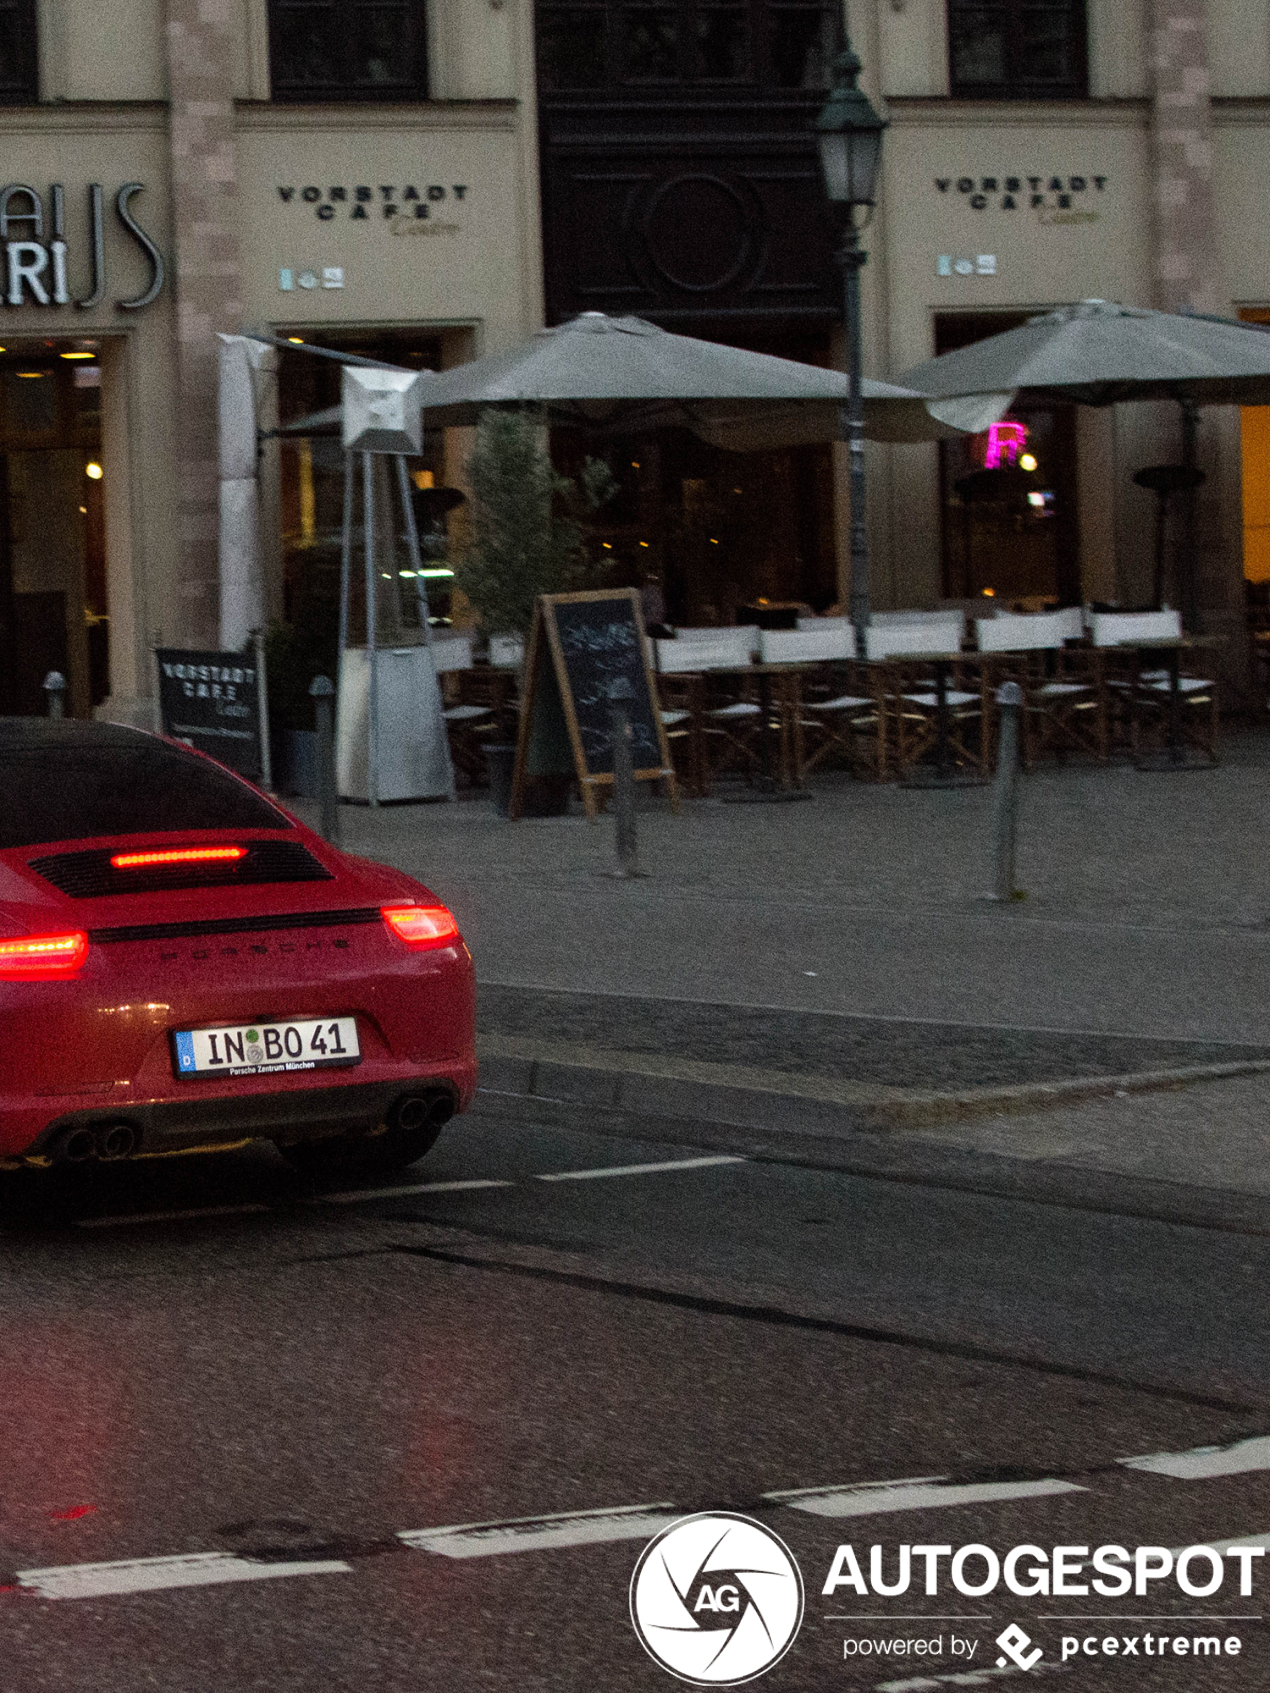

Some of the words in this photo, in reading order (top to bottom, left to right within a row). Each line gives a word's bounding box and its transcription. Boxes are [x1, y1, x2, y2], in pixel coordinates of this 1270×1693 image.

[933, 175, 1109, 193] VORSTADT
[276, 184, 469, 203] VORSTADT
[969, 193, 1074, 211] CAFE
[315, 203, 431, 221] CAFE
[161, 938, 350, 961] PORSCHE
[208, 1031, 246, 1065] IN
[263, 1026, 303, 1060] BO
[310, 1023, 347, 1055] 41
[230, 1066, 256, 1076] Porsche
[257, 1064, 286, 1074] Zentrum
[285, 1061, 316, 1071] München
